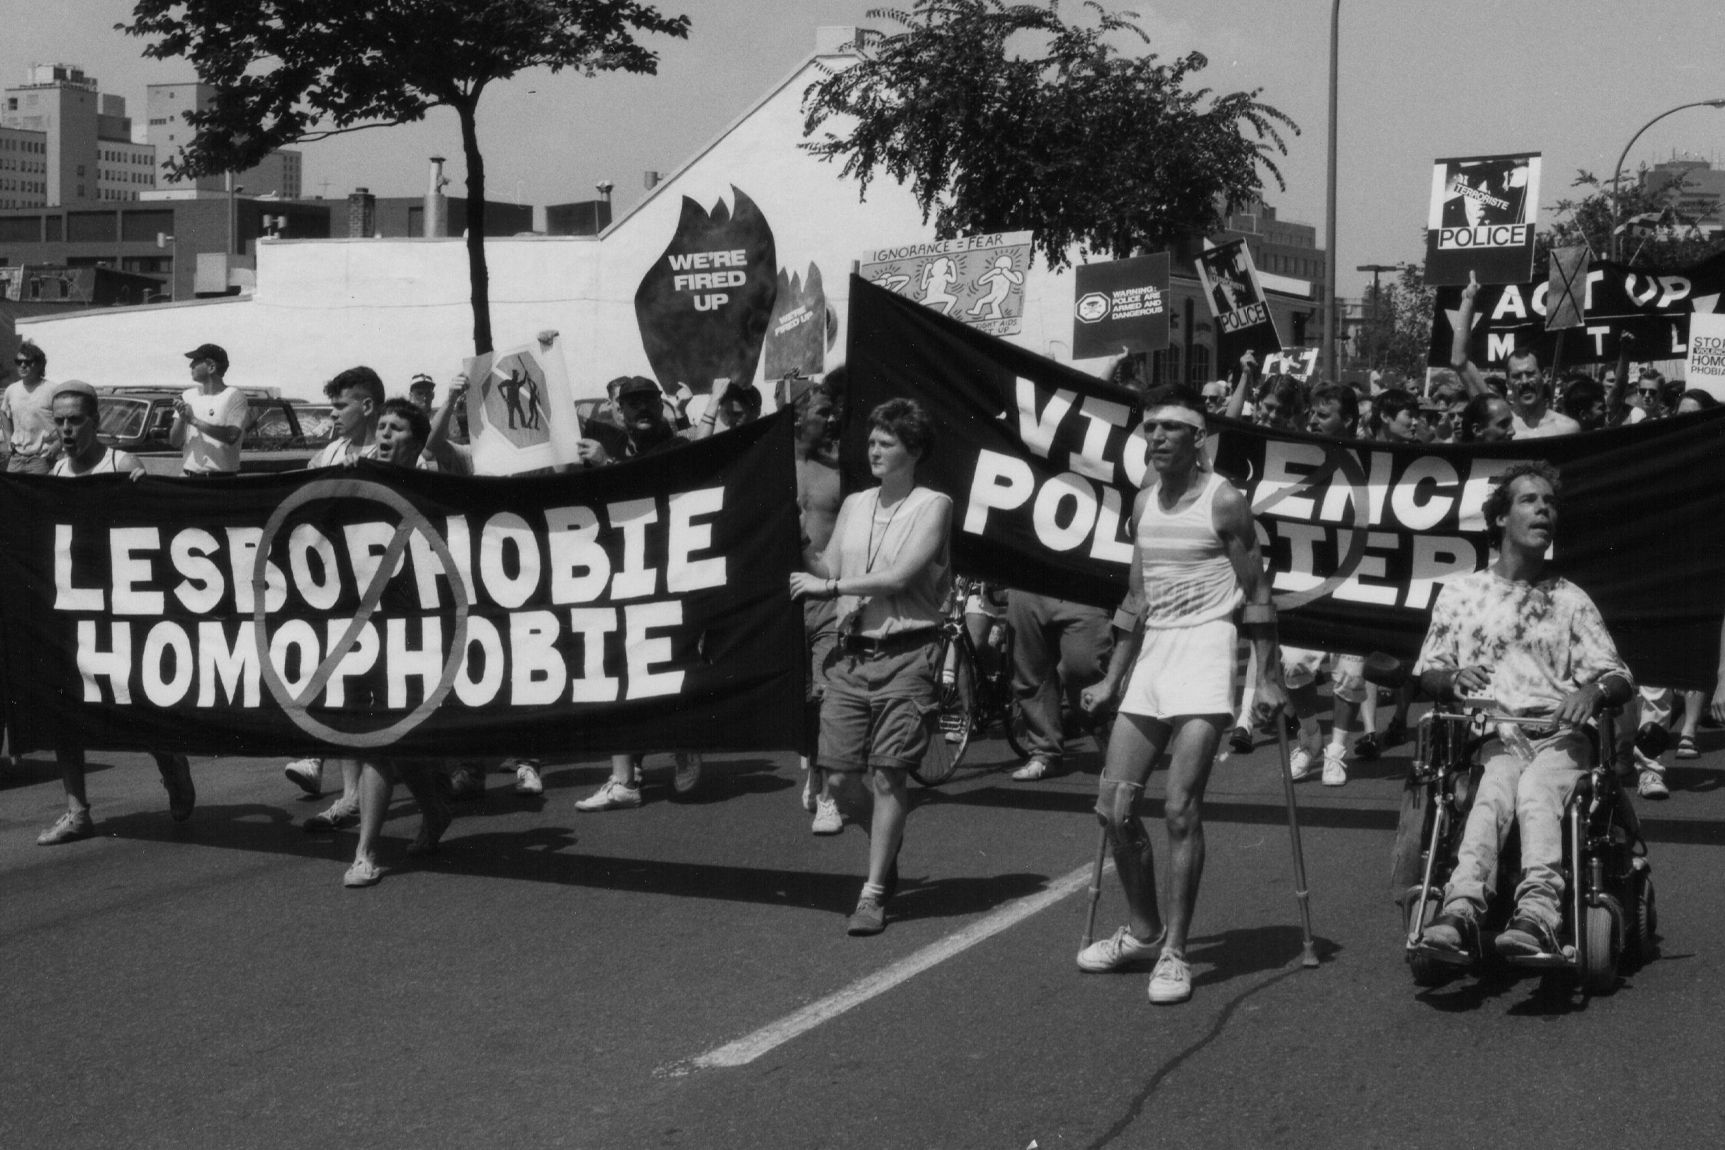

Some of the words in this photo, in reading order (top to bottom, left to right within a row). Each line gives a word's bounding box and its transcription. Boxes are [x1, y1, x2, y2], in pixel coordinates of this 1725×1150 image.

[1454, 183, 1510, 211] TERRORISTE
[873, 241, 950, 262] IGNORANCE
[968, 234, 1003, 249] FEAR
[1440, 225, 1525, 247] POLICE
[668, 249, 747, 271] WE'RE
[674, 270, 747, 291] FIRED
[1625, 273, 1691, 308] UP
[693, 293, 729, 312] UP
[1112, 295, 1142, 305] POLICE
[1144, 291, 1161, 301] ARE
[1112, 303, 1142, 313] ARMED
[1144, 299, 1162, 308] AND
[775, 318, 800, 337] FIRED
[800, 311, 813, 323] UP
[1112, 306, 1163, 320] DANGEROUS
[1220, 304, 1266, 331] POLICE
[1016, 376, 1547, 532] VIENCE
[963, 448, 1553, 609] POLIER
[54, 486, 728, 614] LESBOPHOBIE
[76, 601, 686, 708] HOMOPHOBIE
